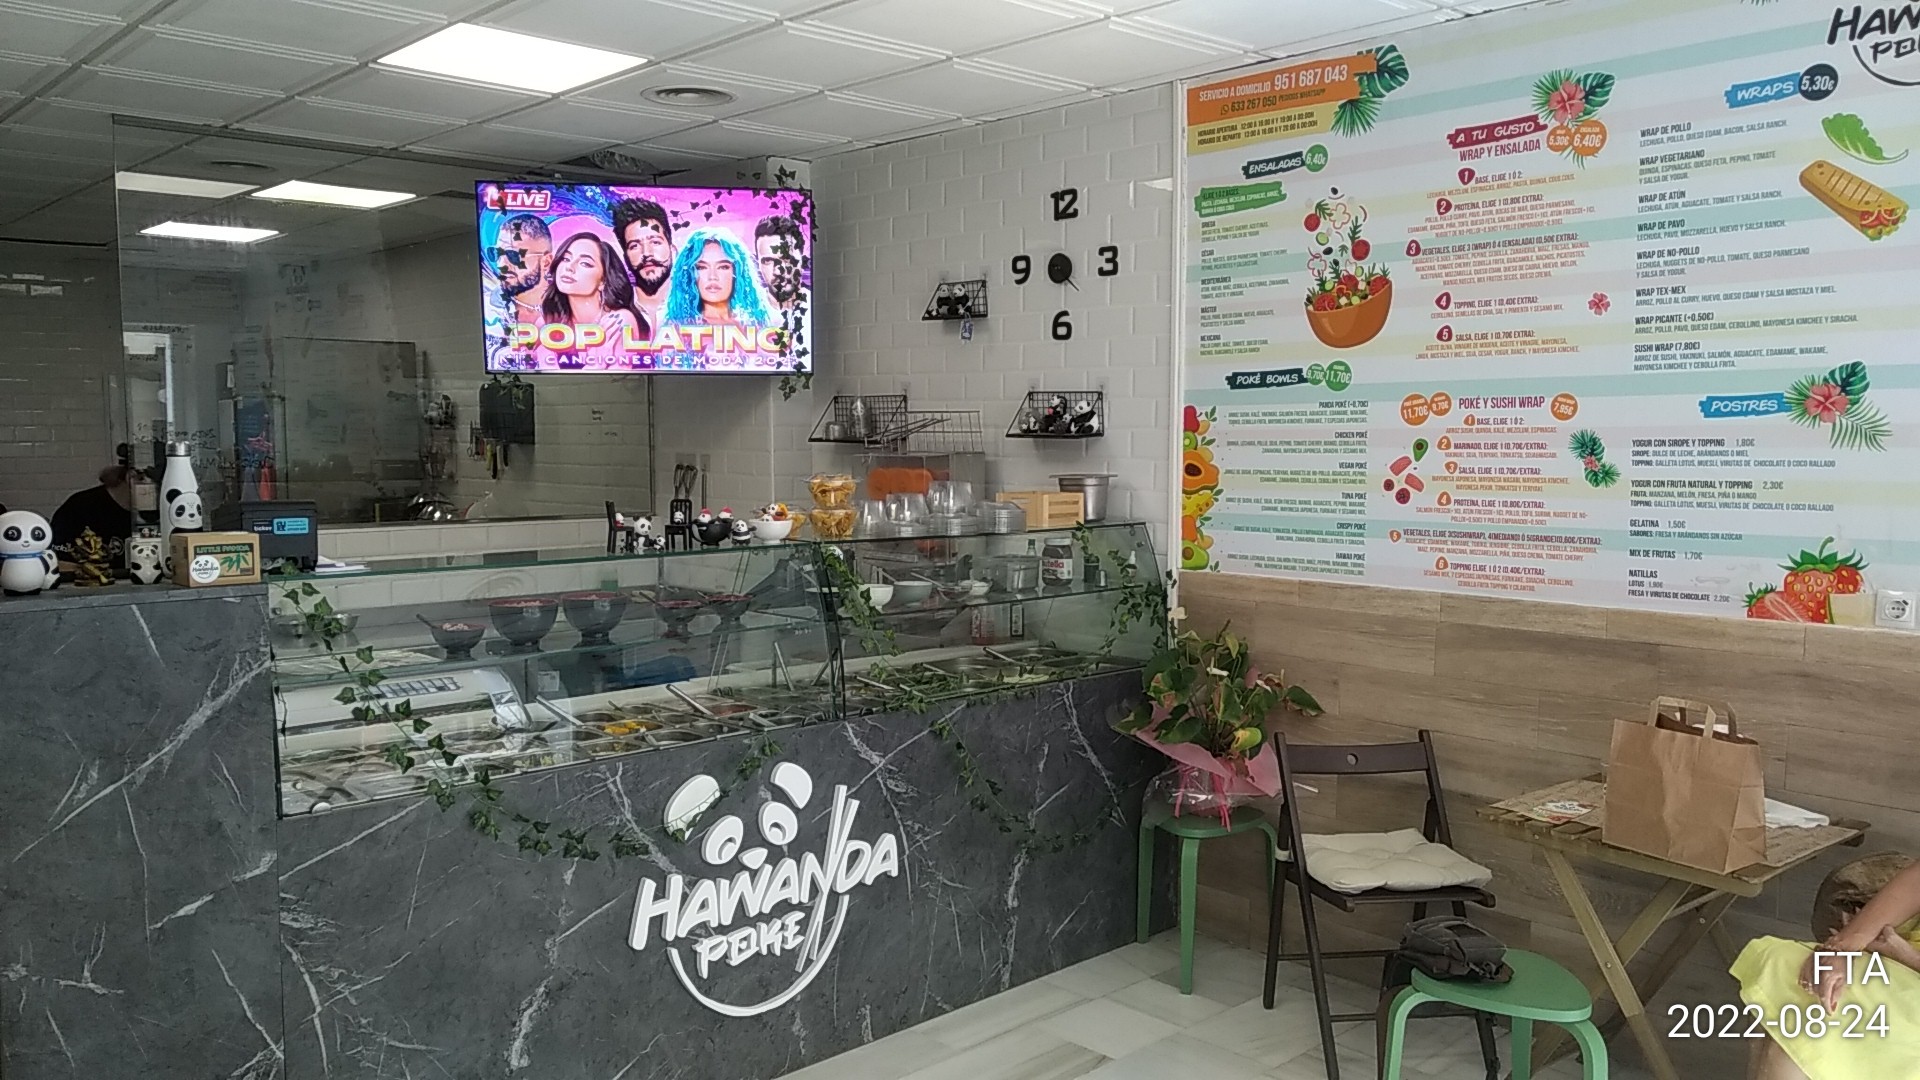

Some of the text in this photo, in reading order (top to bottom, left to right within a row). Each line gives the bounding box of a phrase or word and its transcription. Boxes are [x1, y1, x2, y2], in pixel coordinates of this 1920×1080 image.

[1869, 35, 1920, 64] PO
[1200, 64, 1348, 101] SERVICIO A DOMICILIO 951 687 043
[1738, 75, 1834, 100] WRAPS 5,30€
[1231, 101, 1244, 112] 633
[1247, 98, 1260, 110] 267
[1263, 96, 1276, 108] 050
[1456, 122, 1534, 143] A TU GUSTO
[1641, 122, 1691, 138] WRAP DE POLLO
[1573, 134, 1602, 147] 6,40€
[1460, 139, 1541, 161] WRAP Y ENSALADA
[1640, 149, 1705, 166] WRAP VEGETARIANO
[1249, 157, 1301, 174] ENSALADAS
[1464, 171, 1469, 182] 1
[1475, 175, 1490, 184] BASE,
[1491, 173, 1507, 183] ELIGE
[507, 193, 546, 206] LIVE
[1638, 190, 1686, 204] WRAP DE ATÚN
[1051, 189, 1078, 221] 12
[1638, 219, 1685, 232] WRAP DE PAVO
[1637, 247, 1700, 260] WRAP DE NO-POLLO
[1098, 246, 1118, 276] 3
[1012, 255, 1031, 285] 9
[1636, 286, 1686, 297] WRAP TEX-MEX
[1440, 296, 1447, 307] 4
[1454, 300, 1476, 309] TOPPING,
[1478, 299, 1492, 308] ELIGE
[1052, 310, 1072, 340] 6
[1635, 316, 1654, 325] WRAP
[1655, 314, 1682, 324] PICANTE
[509, 323, 606, 350] POP
[1442, 329, 1449, 340] 5
[1456, 333, 1473, 342] SALSA,
[1474, 332, 1488, 341] ELIGE
[1635, 344, 1653, 352] SUSHI
[1655, 343, 1673, 352] WRAP
[546, 355, 797, 366] CANCIONES DE MODA 202
[1634, 363, 1662, 372] MAYONESA
[1664, 362, 1687, 370] KIMCHEE
[1689, 362, 1692, 370] Y
[1694, 361, 1718, 369] CEBOLLA
[1237, 374, 1260, 385] POKÉ
[1266, 372, 1298, 384] BOWLS
[1459, 396, 1480, 409] POKÉ
[1484, 397, 1489, 408] Y
[1491, 396, 1516, 408] SUSHI
[1518, 396, 1545, 408] WRAP
[1711, 400, 1778, 412] POSTRES
[1668, 439, 1691, 447] SIROPE
[1692, 439, 1696, 447] Y
[1698, 439, 1725, 447] TOPPING
[1631, 480, 1651, 488] YOGUR
[1653, 480, 1665, 488] CON
[1688, 481, 1717, 489] NATURAL
[1719, 481, 1722, 489] Y
[1725, 481, 1752, 489] TOPPING
[1337, 522, 1353, 530] CRISPY
[1630, 520, 1659, 528] GELATINA
[1629, 549, 1641, 558] MIX
[1643, 550, 1650, 558] DE
[1652, 550, 1675, 559] FRUTAS
[1629, 570, 1657, 578] NATILLAS
[1628, 590, 1644, 598] FRESA
[1650, 591, 1670, 599] VIRUTAS
[1680, 593, 1710, 601] CHOCOLATE
[628, 833, 898, 950] HAWANDA
